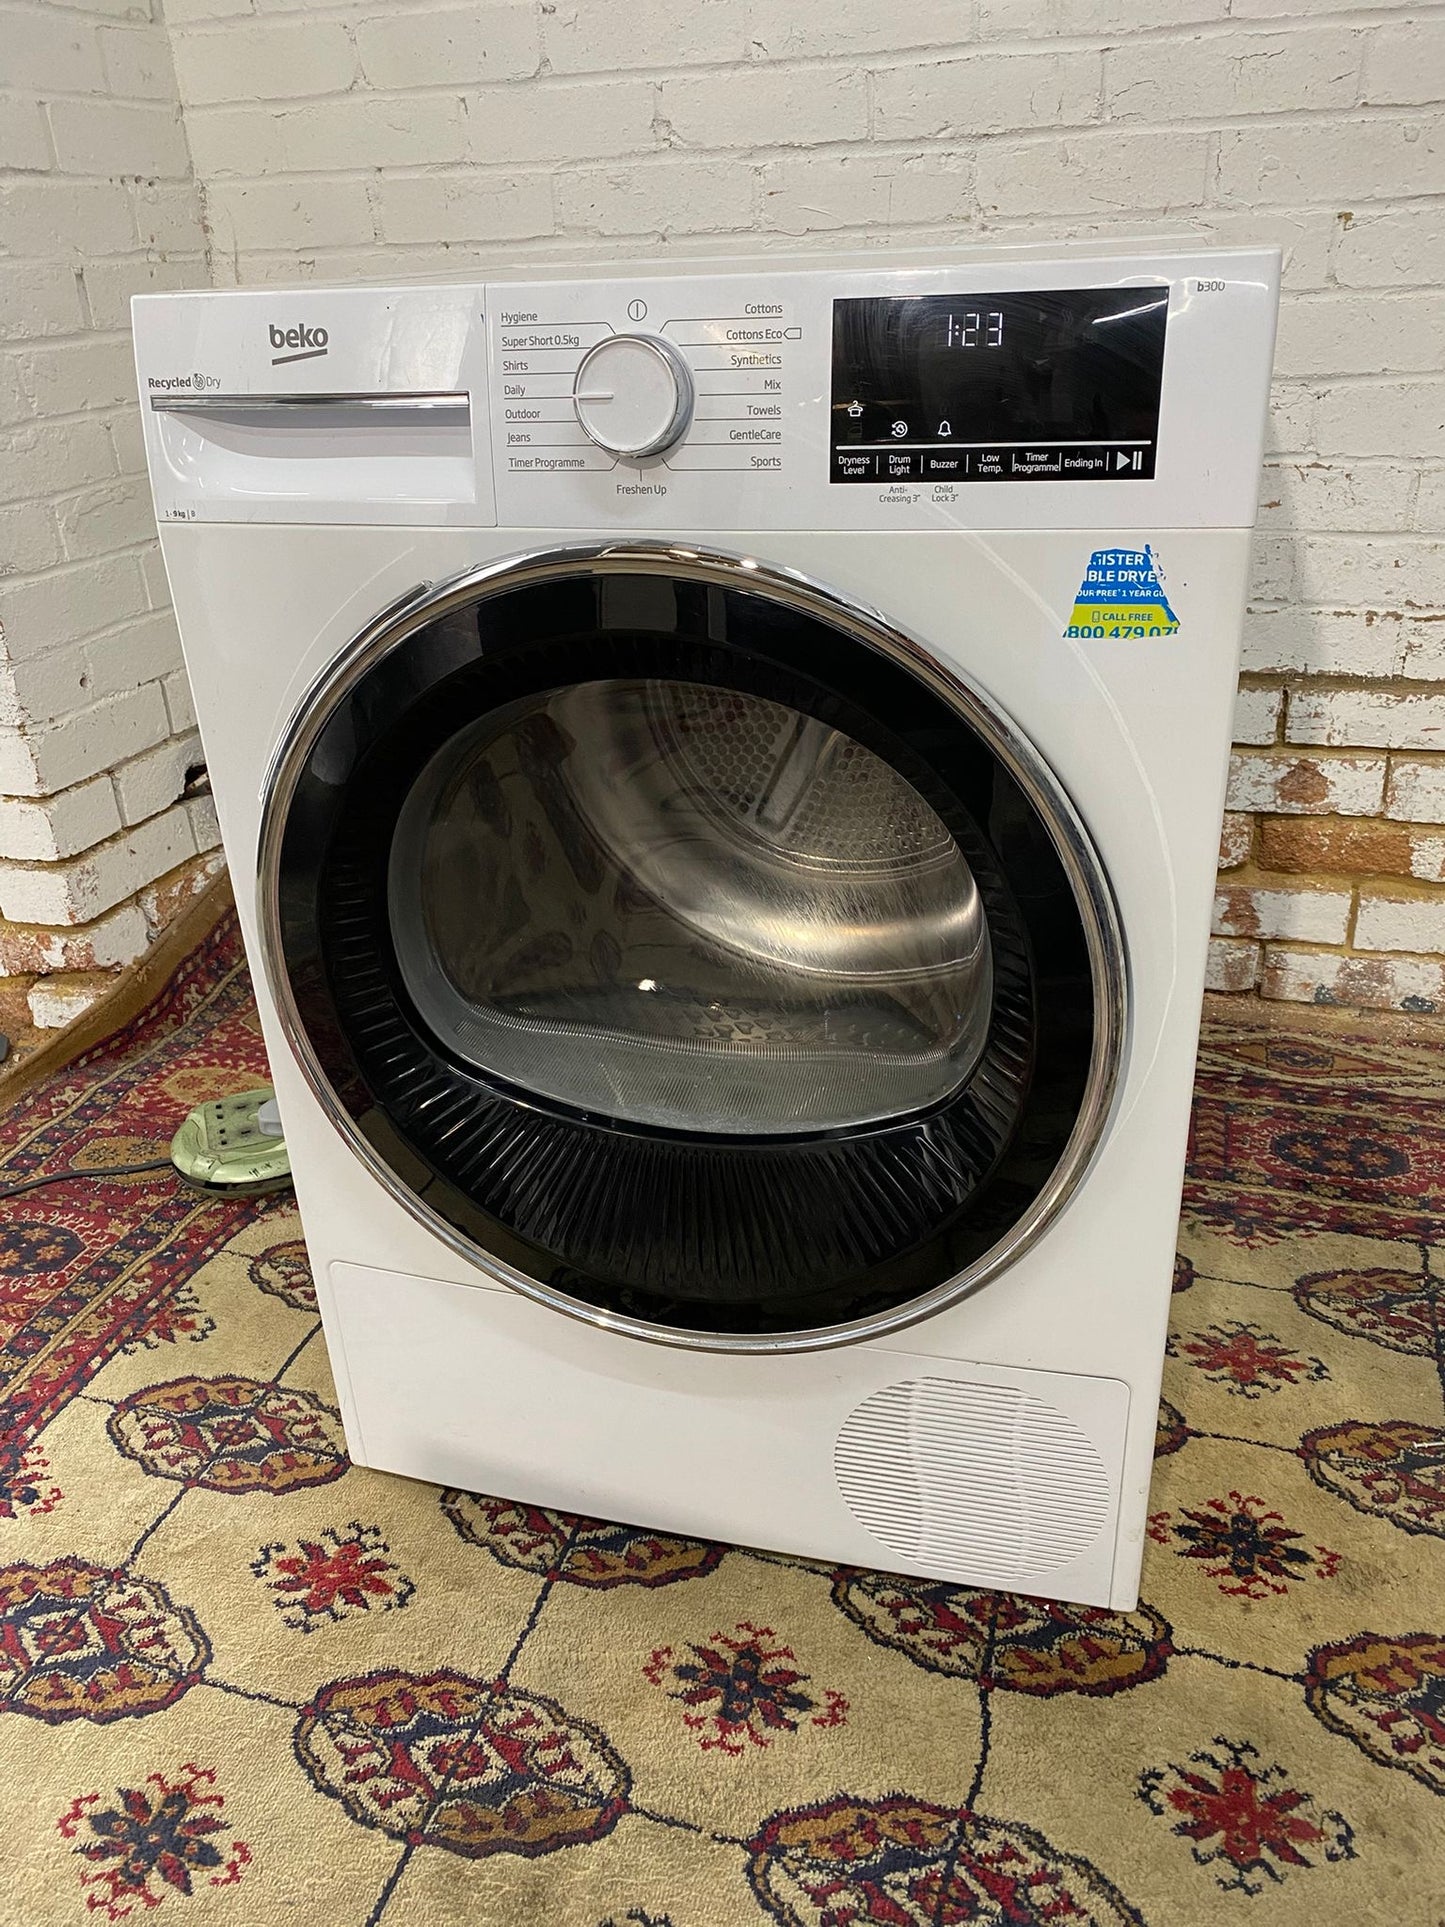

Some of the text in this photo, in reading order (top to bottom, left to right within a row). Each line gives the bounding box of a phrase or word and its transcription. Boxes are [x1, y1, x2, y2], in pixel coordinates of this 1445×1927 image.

[1197, 280, 1225, 292] b300
[745, 303, 783, 314] Cottons
[501, 312, 537, 322] Hygiene
[726, 329, 782, 340] Cottons Eco
[948, 312, 1002, 347] 1:23
[269, 323, 329, 349] beko
[502, 335, 579, 347] Super Short 0.5kg
[503, 360, 528, 370] Shirts
[731, 354, 782, 366] Synthetics
[148, 376, 221, 390] Recycled Dry
[764, 380, 781, 390] Mix
[505, 385, 525, 396] Daily
[505, 408, 540, 419] Outdoor
[747, 405, 781, 415] Towels
[508, 432, 531, 443] Jeans
[729, 430, 781, 440] GentleCare
[751, 457, 781, 468] Sports
[838, 456, 870, 465] Dryness
[889, 455, 910, 464] Drum
[981, 454, 999, 463] Low
[1025, 452, 1049, 462] Timer
[509, 458, 585, 469] Timer Programme
[844, 464, 865, 474] Level
[930, 459, 958, 469] Buzzer
[978, 463, 1003, 474] Temp.
[1015, 462, 1059, 473] Programme
[1065, 458, 1103, 469] Ending In
[890, 464, 910, 475] Light
[617, 485, 667, 496] Freshen Up
[889, 486, 908, 494] Anti-
[934, 485, 953, 494] Child
[879, 494, 911, 504] Creasing
[932, 494, 950, 503] Lock
[1103, 613, 1152, 621] CALL FREE
